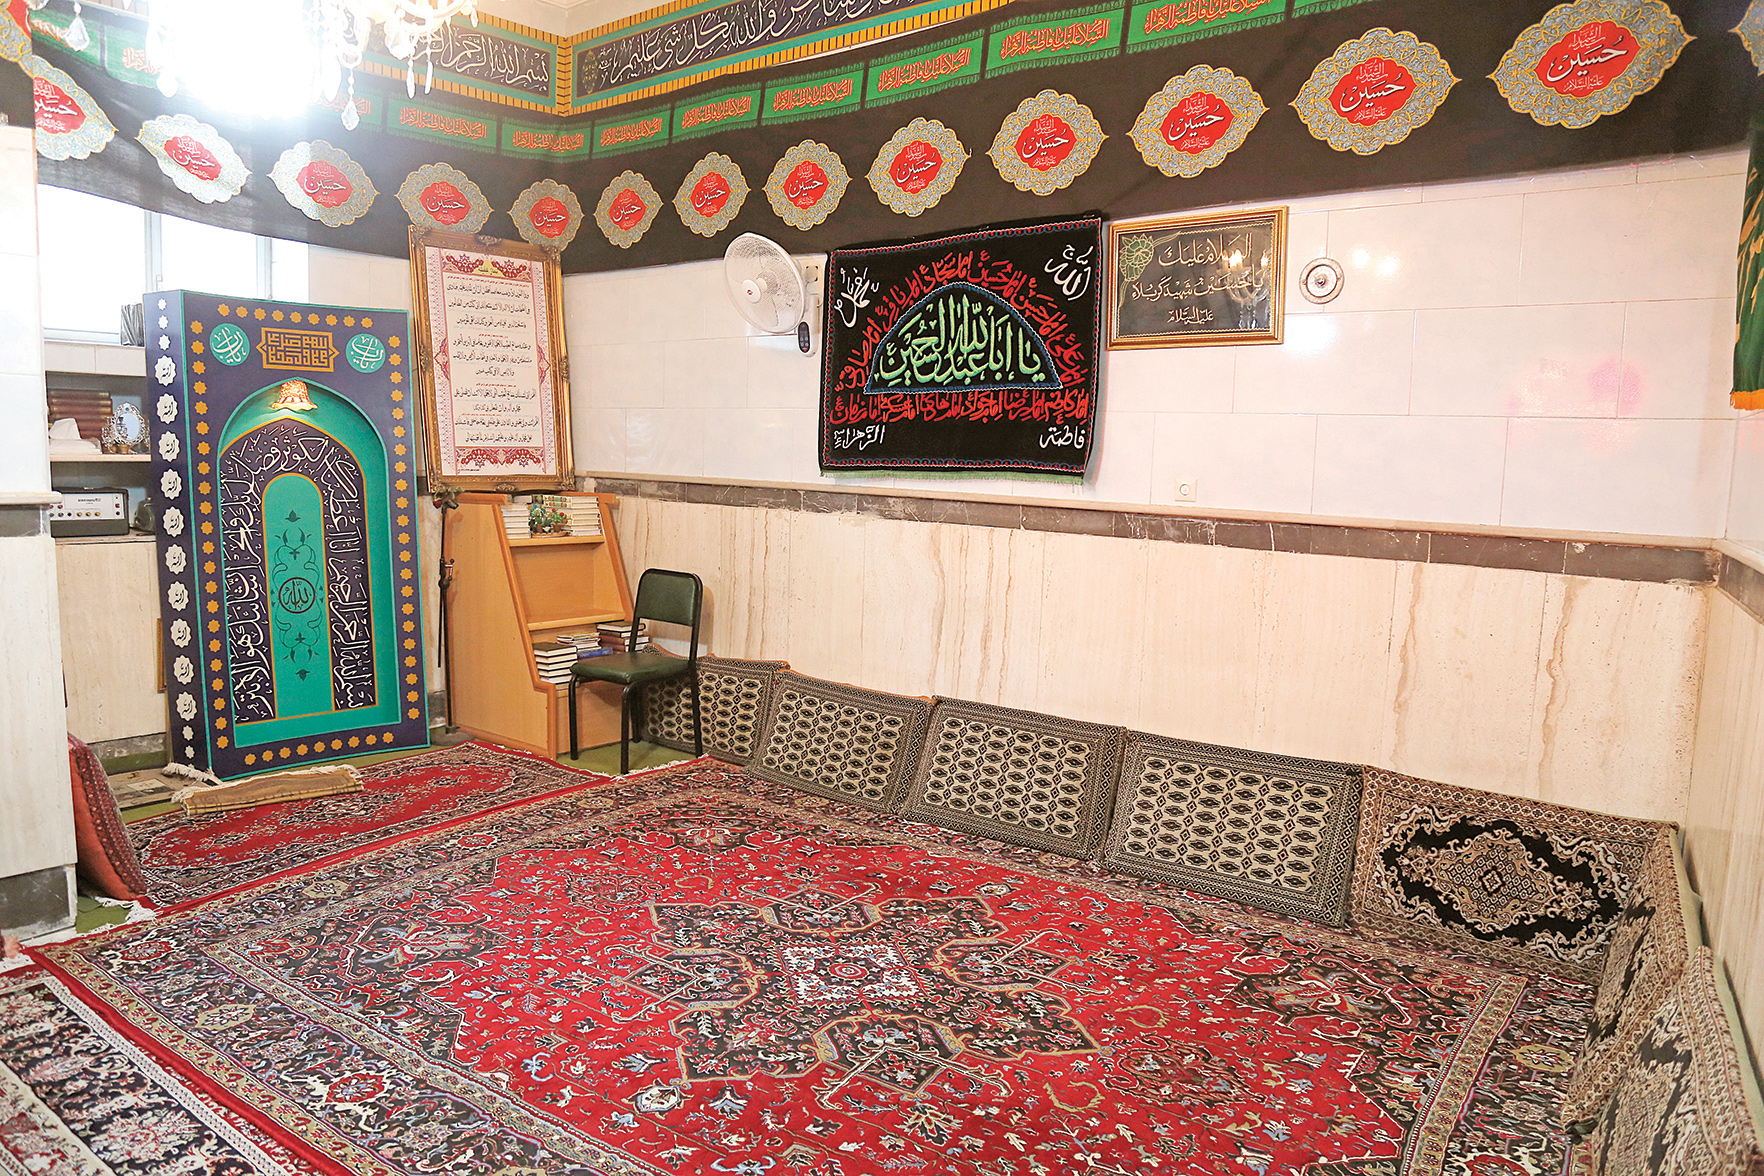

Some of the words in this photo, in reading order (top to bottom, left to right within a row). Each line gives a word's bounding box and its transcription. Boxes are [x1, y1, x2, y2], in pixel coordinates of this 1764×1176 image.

[1547, 35, 1628, 82] حسین
[1340, 73, 1406, 112] حسین
[1169, 104, 1225, 141] حسین
[1202, 232, 1252, 264] اللام
